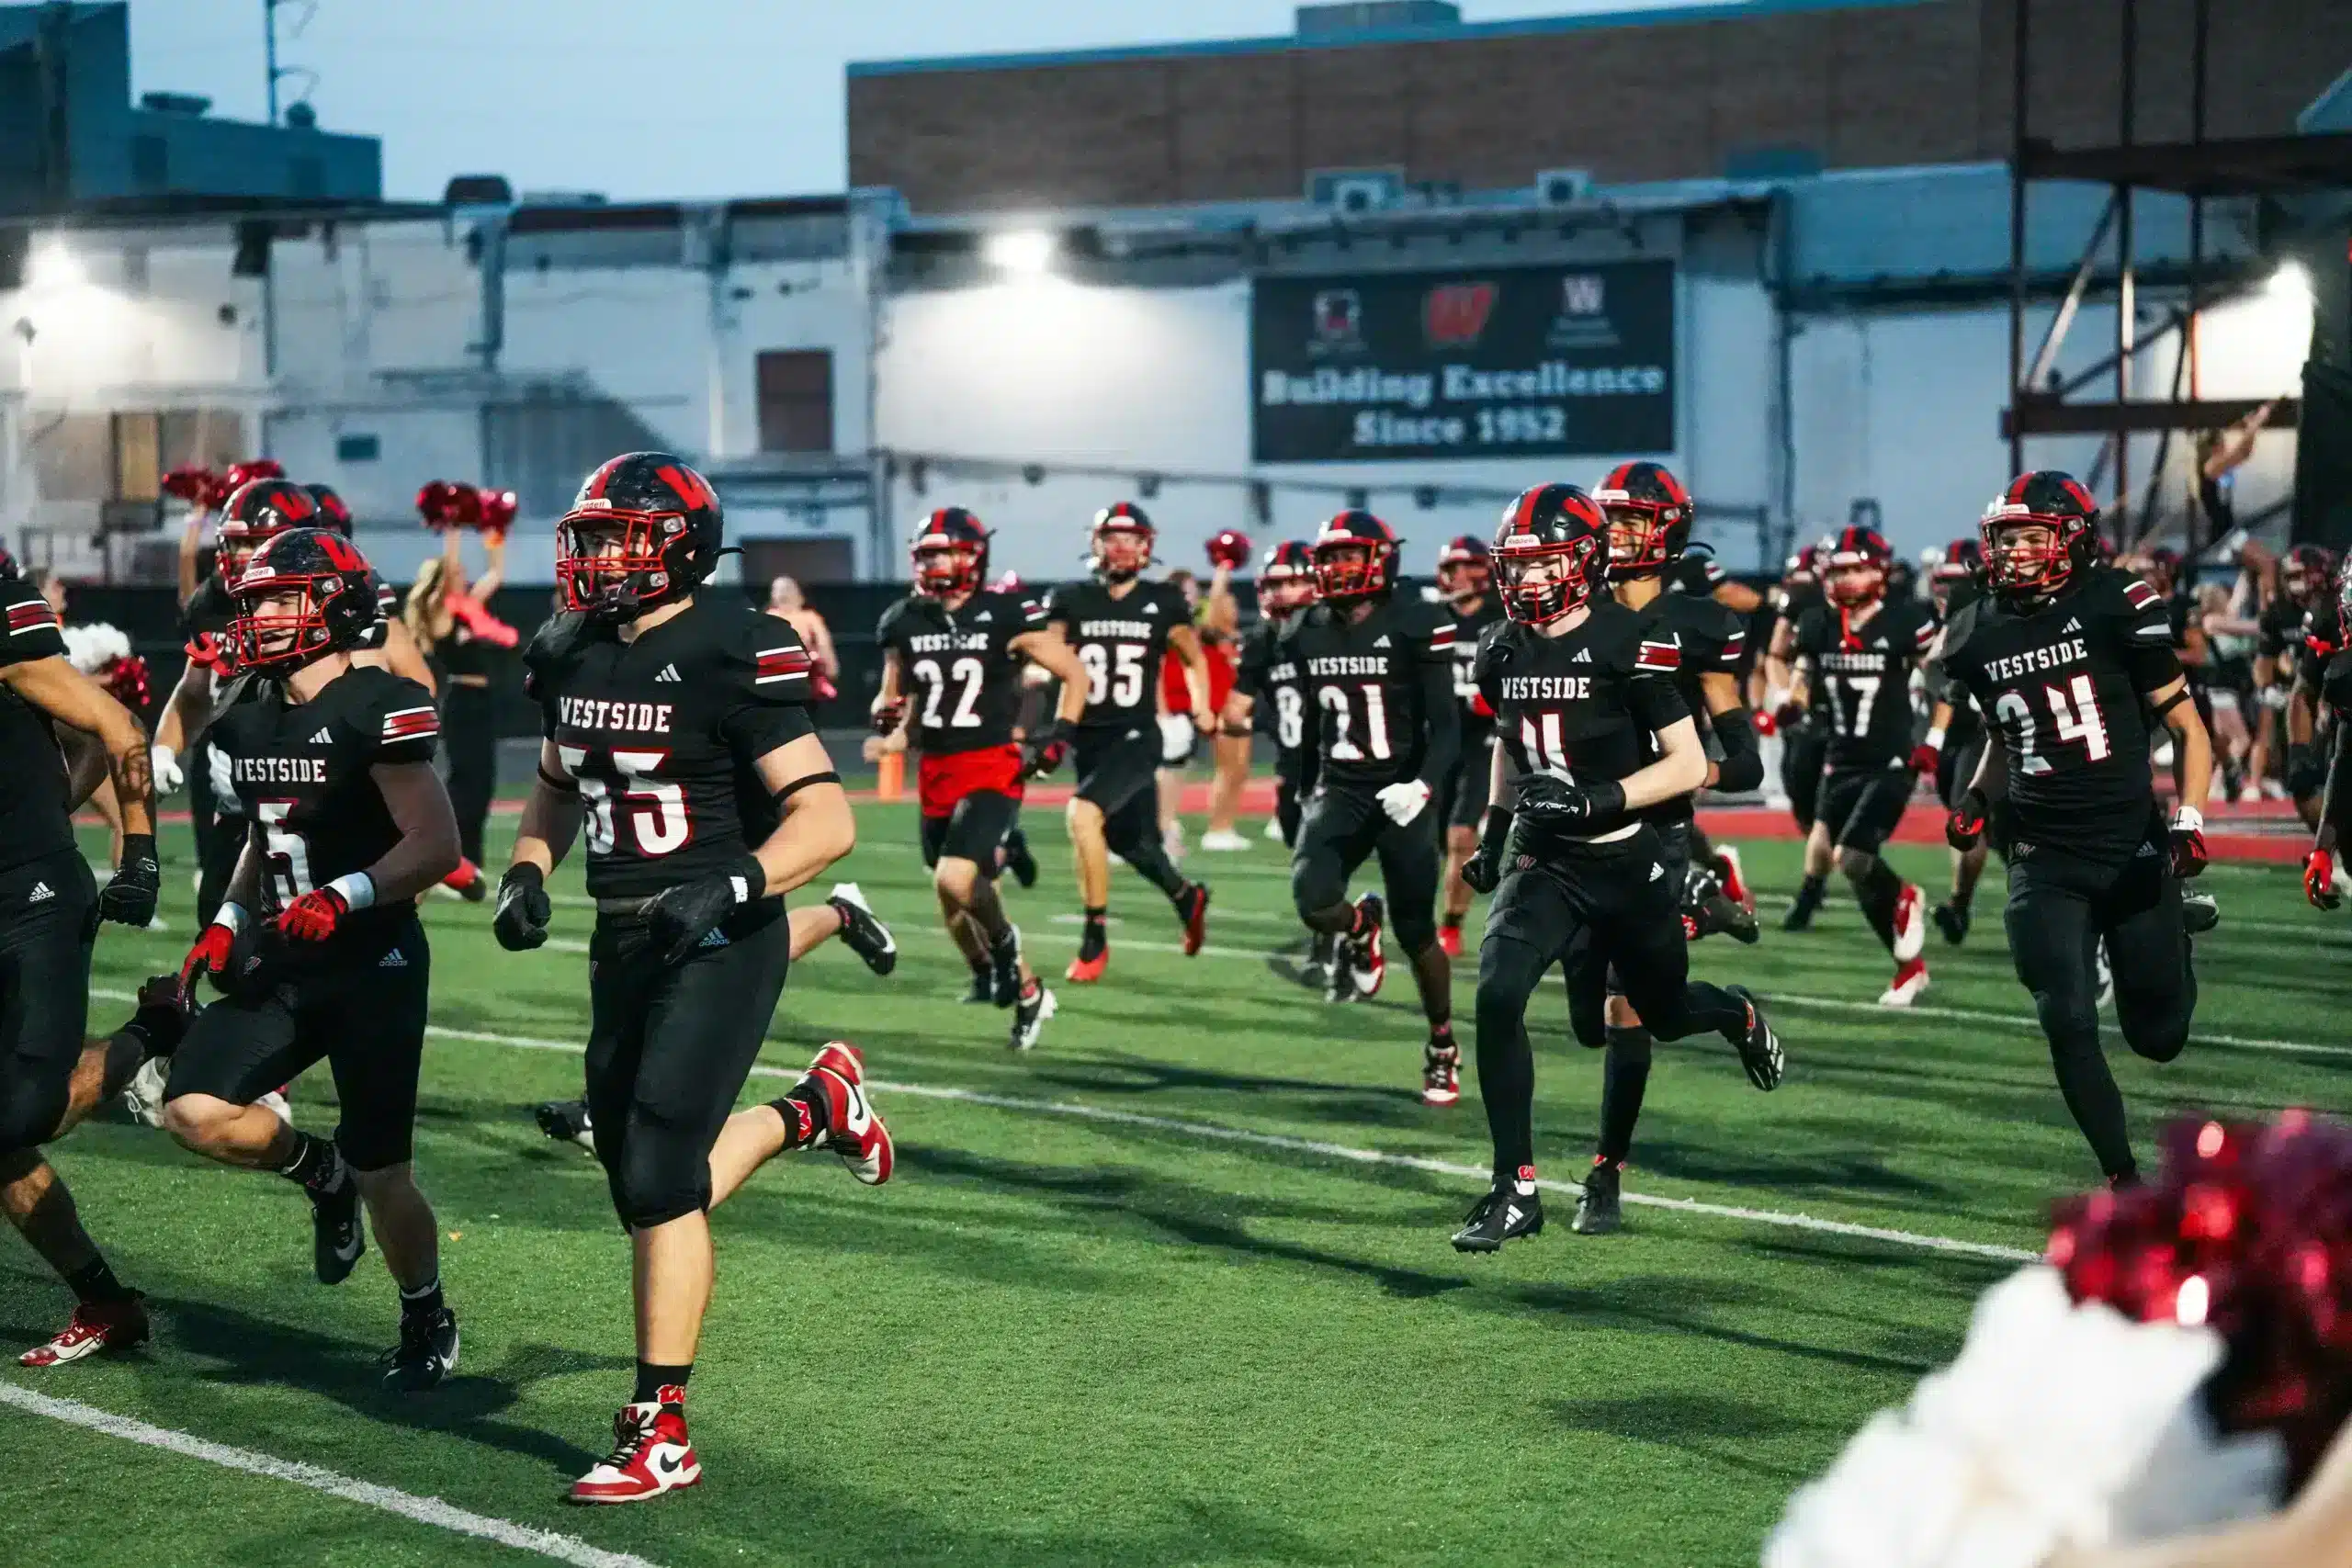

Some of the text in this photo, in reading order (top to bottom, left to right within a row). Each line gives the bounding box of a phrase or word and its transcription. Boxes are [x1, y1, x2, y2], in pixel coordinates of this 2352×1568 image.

[1261, 358, 1668, 408] Building Excellence
[1352, 410, 1466, 446] Since
[913, 657, 984, 728] 22
[1318, 683, 1391, 760] 21
[1824, 675, 1882, 738] 17
[1996, 673, 2110, 776] 24
[558, 742, 689, 855] 55
[257, 800, 314, 909] 5
[28, 890, 55, 902] adidas
[379, 959, 408, 967] adidas
[698, 938, 730, 947] adidas
